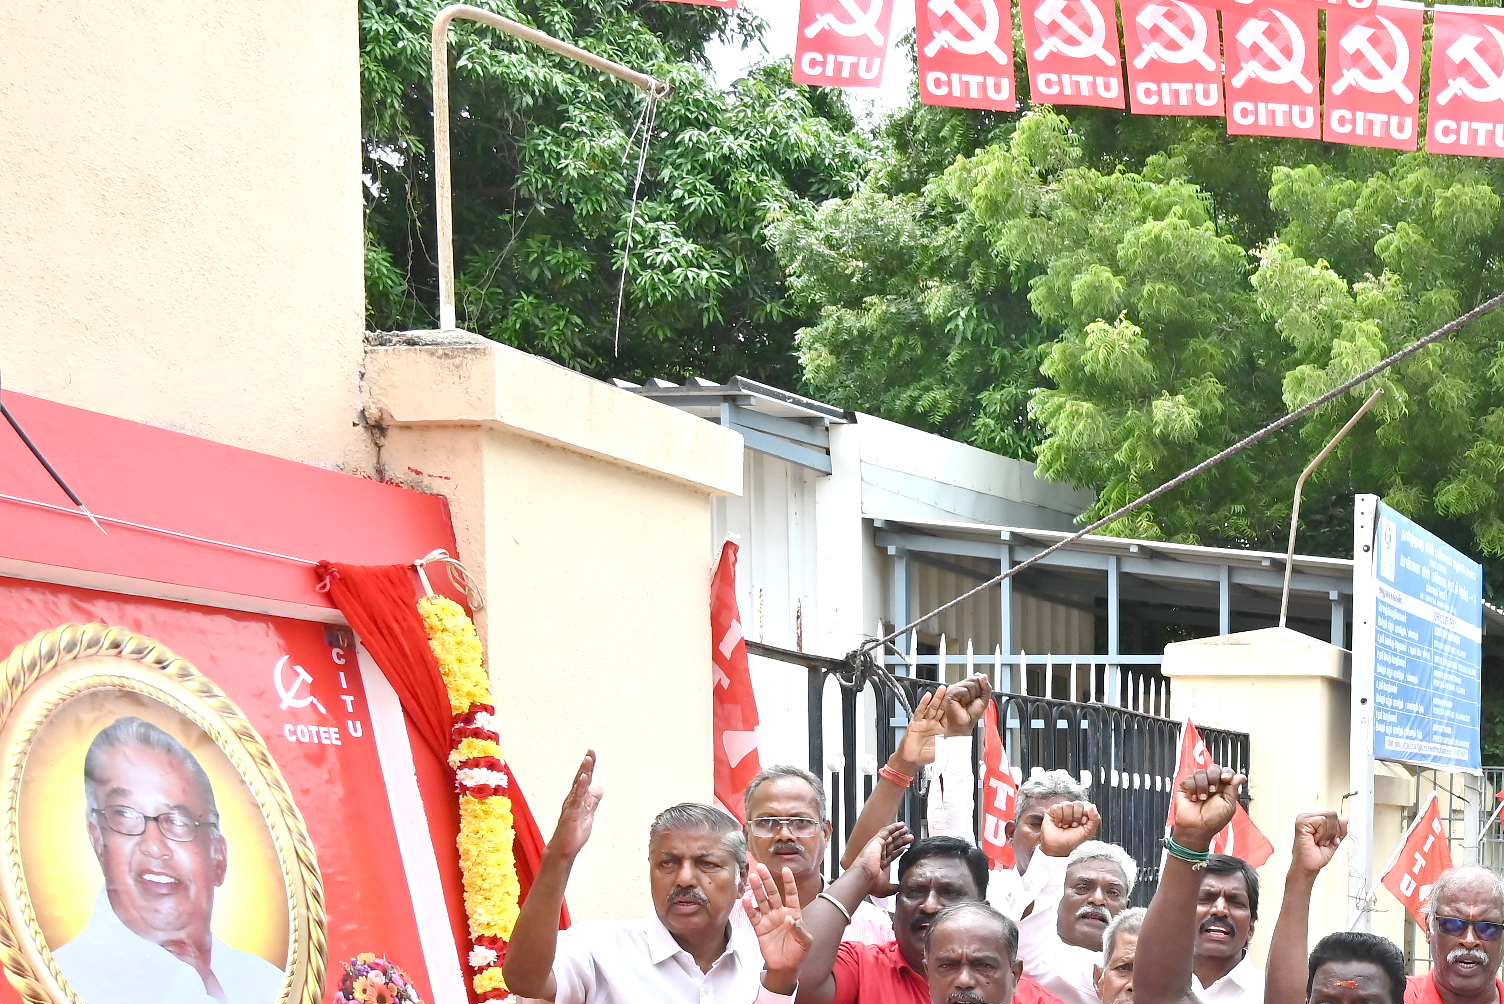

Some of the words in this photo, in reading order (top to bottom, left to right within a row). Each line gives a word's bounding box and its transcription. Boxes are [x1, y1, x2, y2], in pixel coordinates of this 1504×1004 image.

[801, 51, 881, 80] CITU
[925, 71, 1010, 101] CITU
[1036, 72, 1119, 98] CITU
[1136, 82, 1218, 106] CITU
[1232, 101, 1315, 129] CITU
[1330, 109, 1413, 140] CITU
[332, 648, 363, 737] CITU
[284, 724, 342, 745] COTEE
